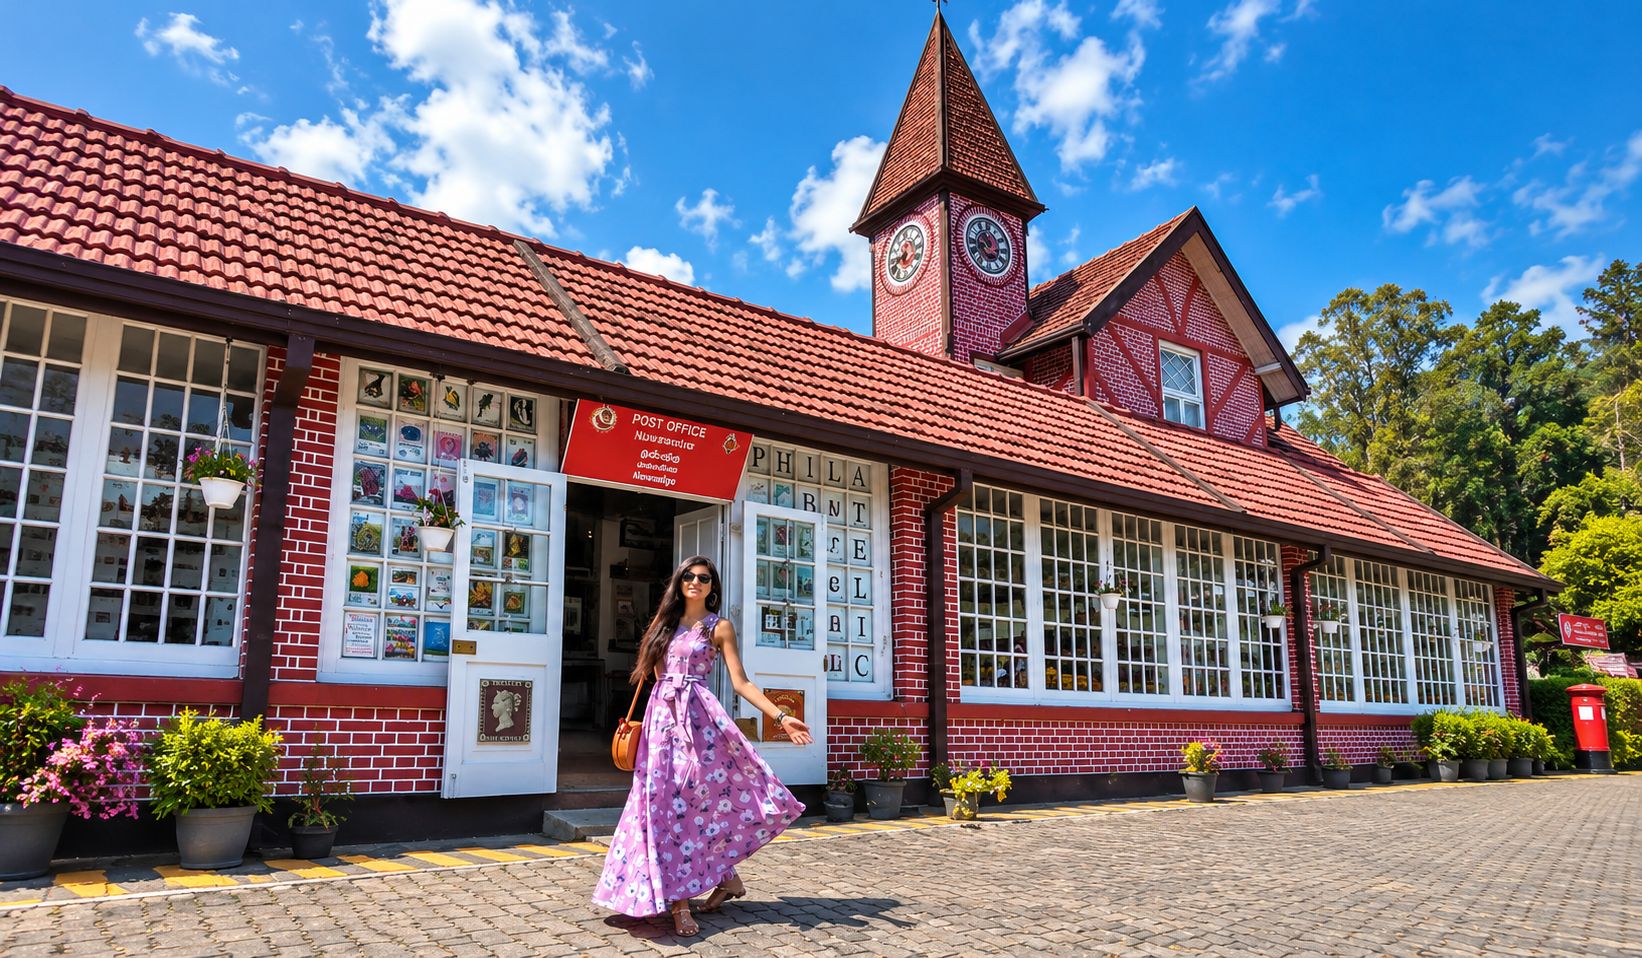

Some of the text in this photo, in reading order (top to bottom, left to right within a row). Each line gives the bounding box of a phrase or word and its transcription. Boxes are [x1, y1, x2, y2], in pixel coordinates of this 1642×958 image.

[632, 414, 707, 438] POST OFFICE
[753, 446, 866, 488] PHILA
